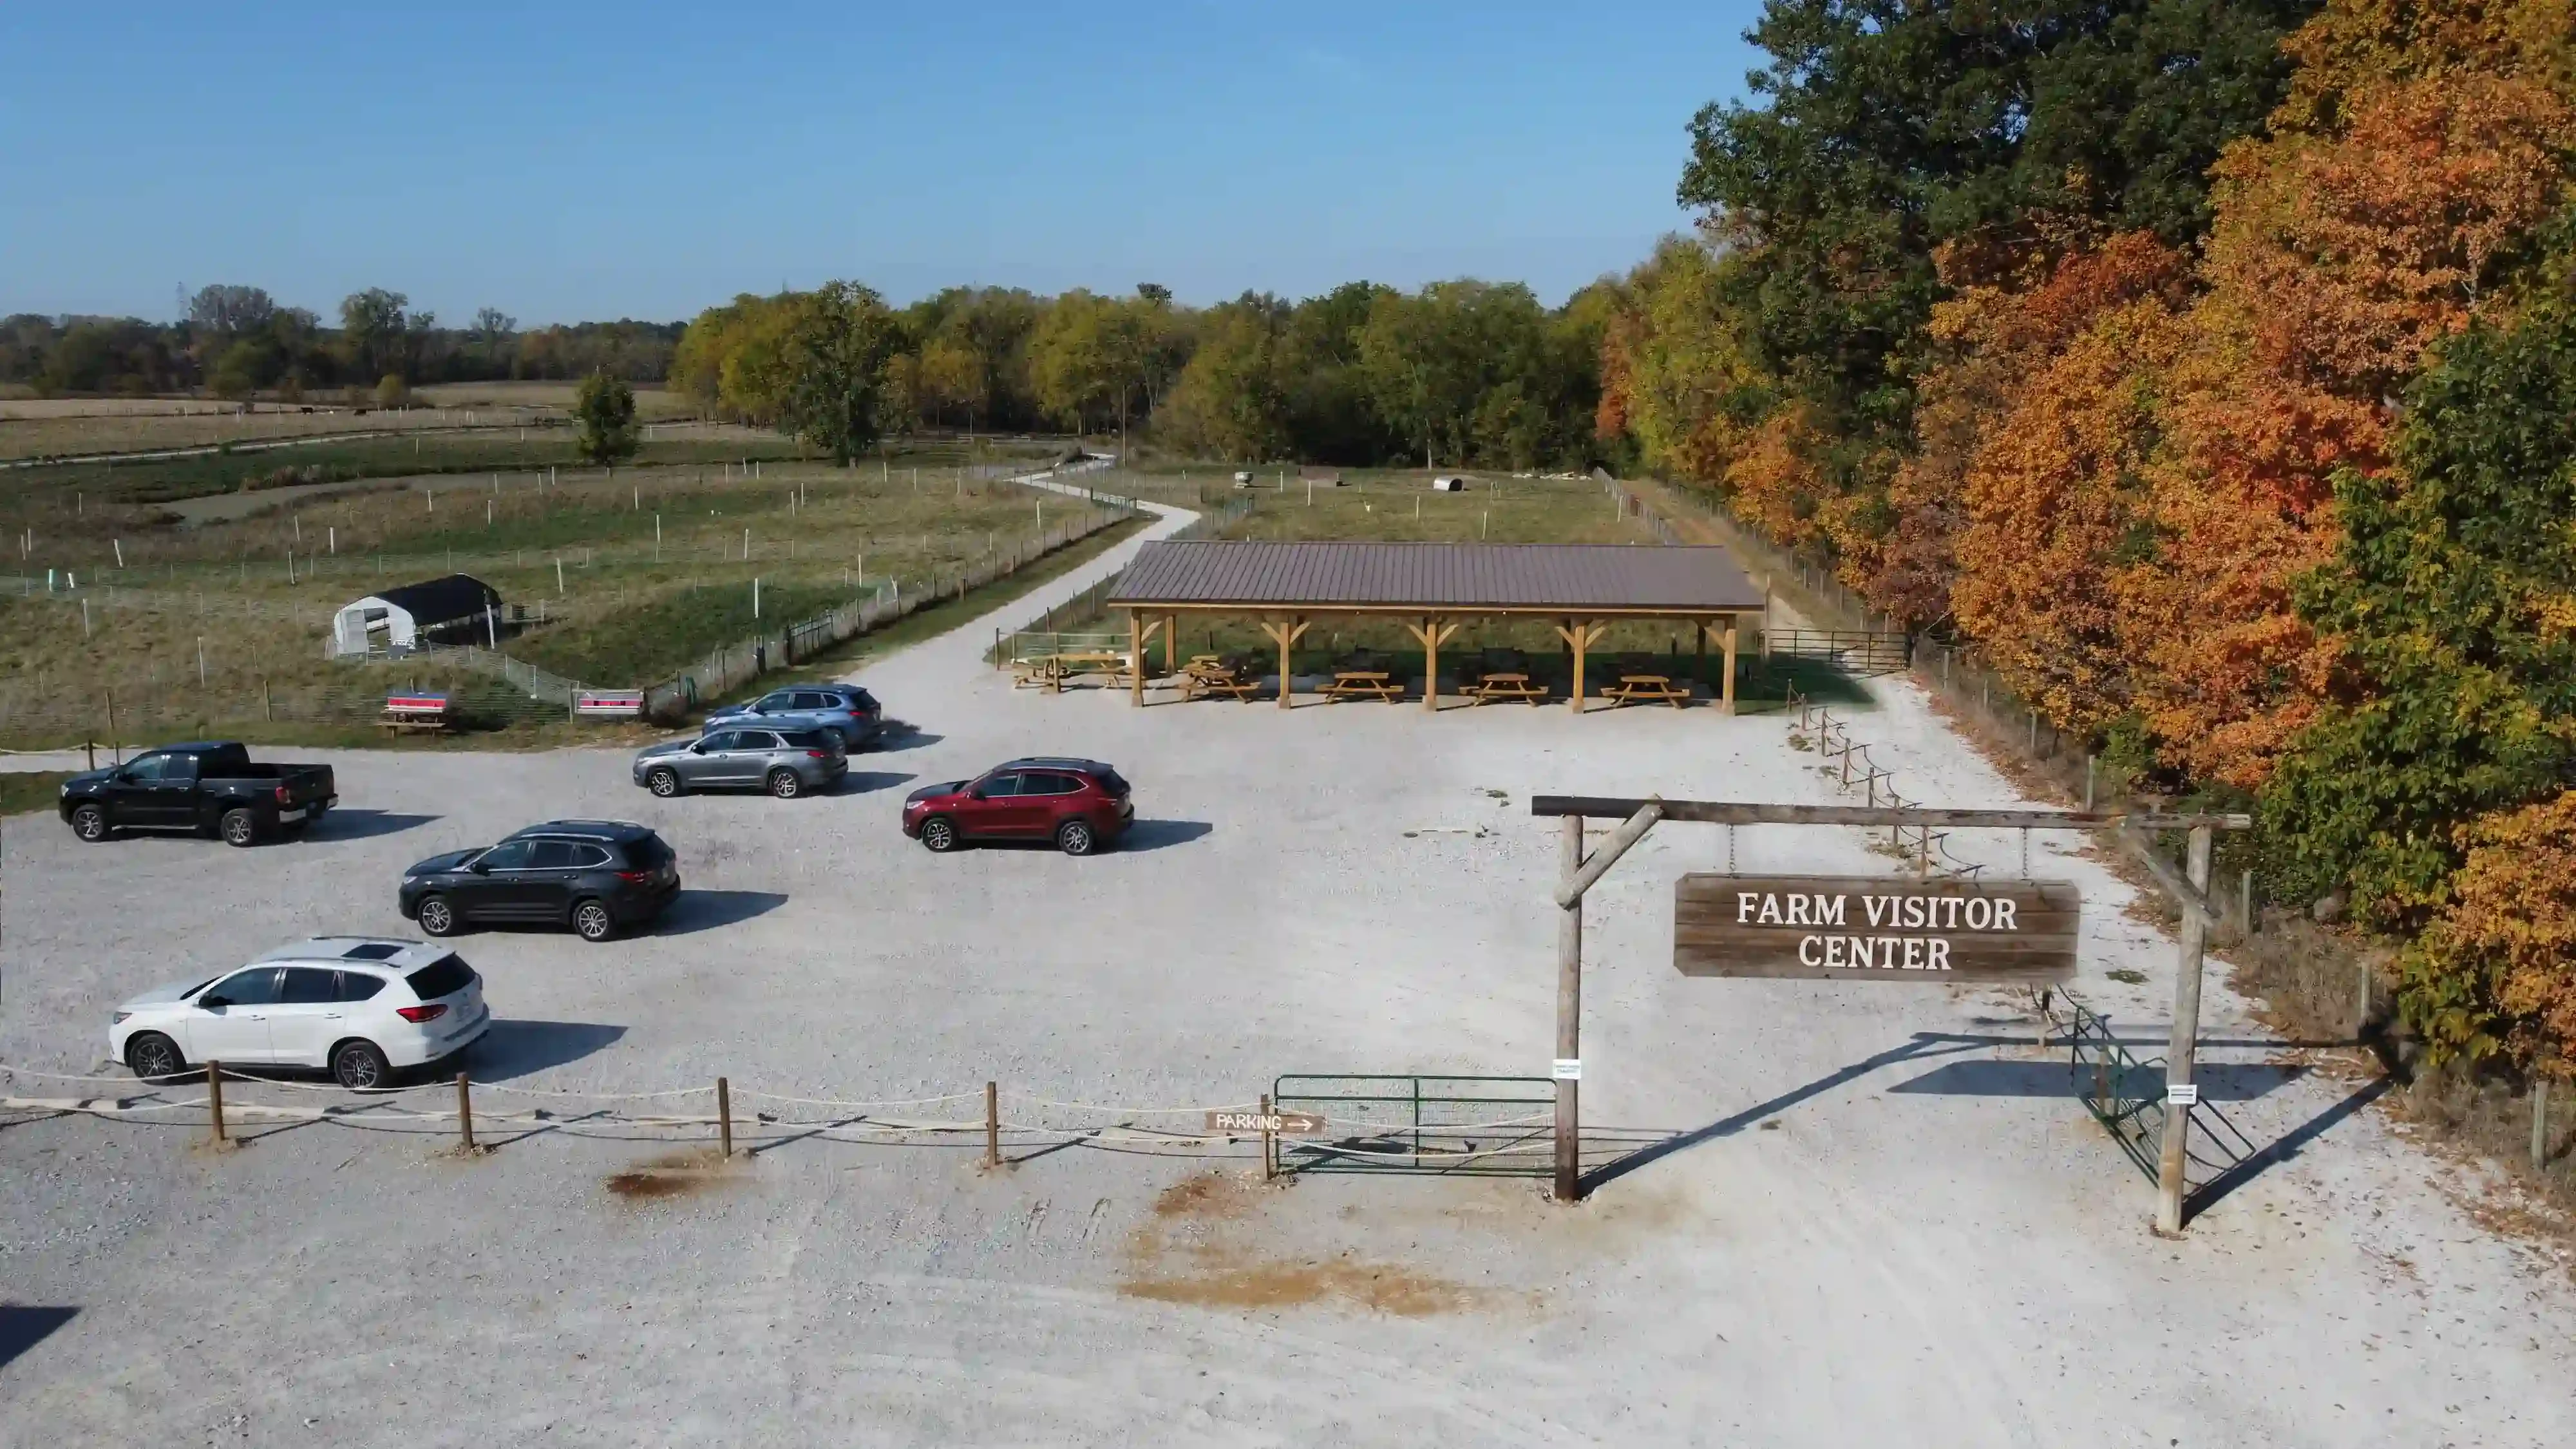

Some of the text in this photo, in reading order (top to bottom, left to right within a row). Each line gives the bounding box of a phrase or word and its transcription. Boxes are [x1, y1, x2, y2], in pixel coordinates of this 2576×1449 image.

[1737, 893, 2018, 931] FARM VISITOR
[1799, 936, 1952, 971] CENTER
[1216, 1113, 1282, 1130] PARKING
